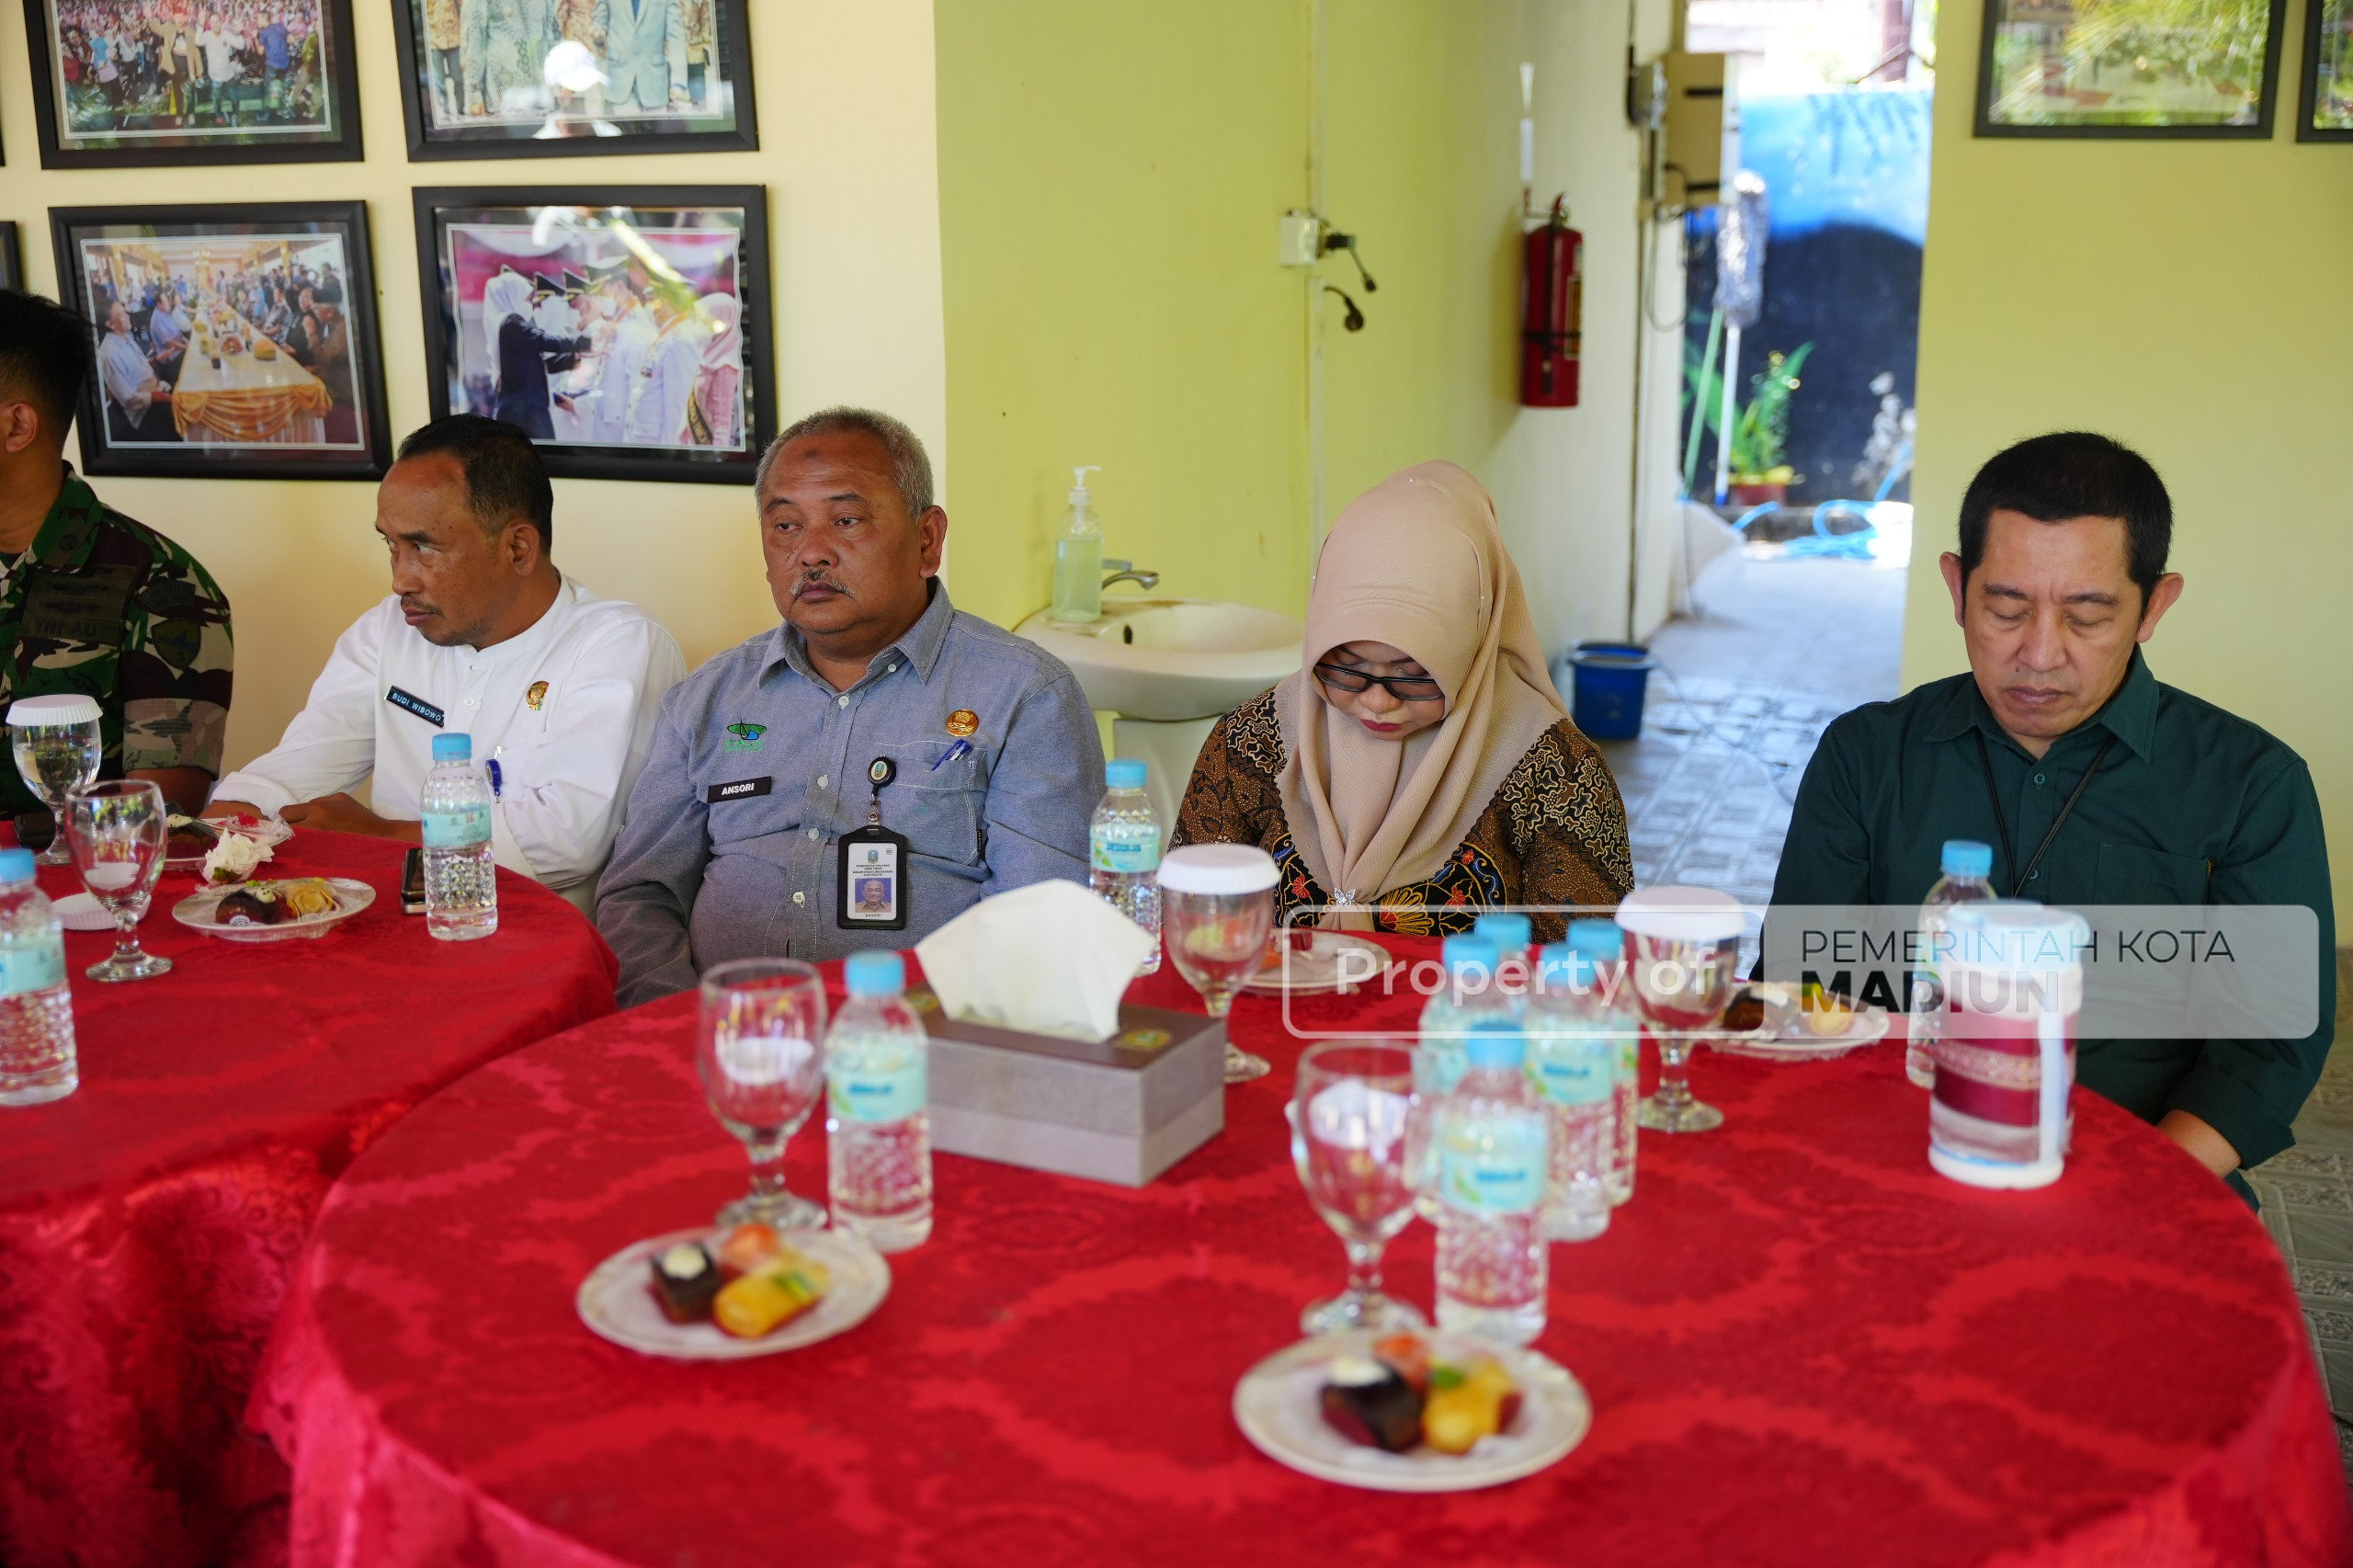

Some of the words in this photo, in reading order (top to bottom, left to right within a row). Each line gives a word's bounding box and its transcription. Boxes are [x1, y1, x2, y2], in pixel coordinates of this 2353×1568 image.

[392, 692, 409, 706] BUDI
[412, 702, 442, 722] WIBOWO
[721, 782, 756, 796] ANSORI
